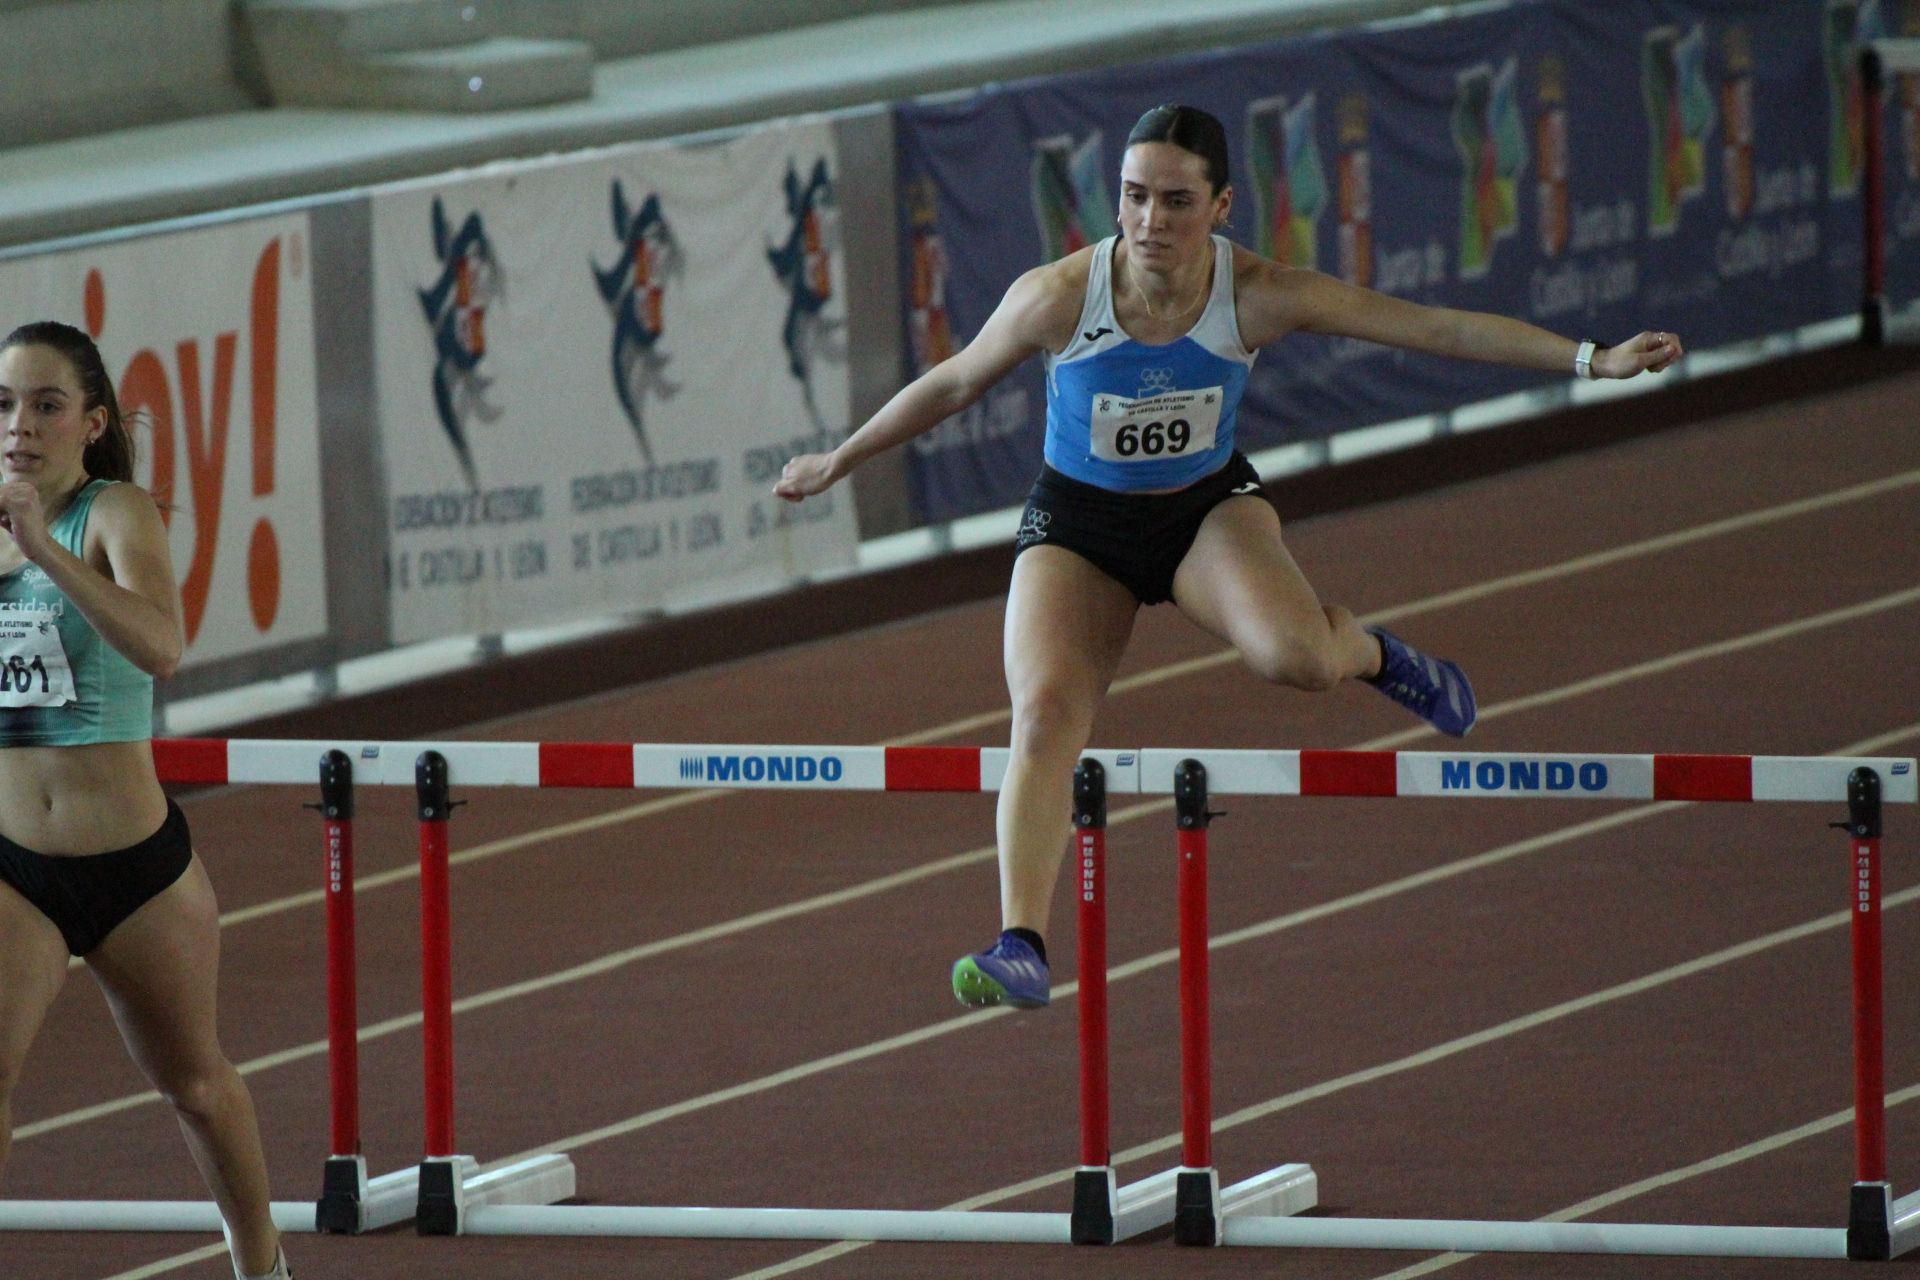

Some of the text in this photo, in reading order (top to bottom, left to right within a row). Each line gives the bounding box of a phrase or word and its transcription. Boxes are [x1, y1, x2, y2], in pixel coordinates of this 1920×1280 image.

[1115, 418, 1191, 457] 669
[706, 755, 843, 782] MONDO
[1441, 760, 1609, 792] MONDO
